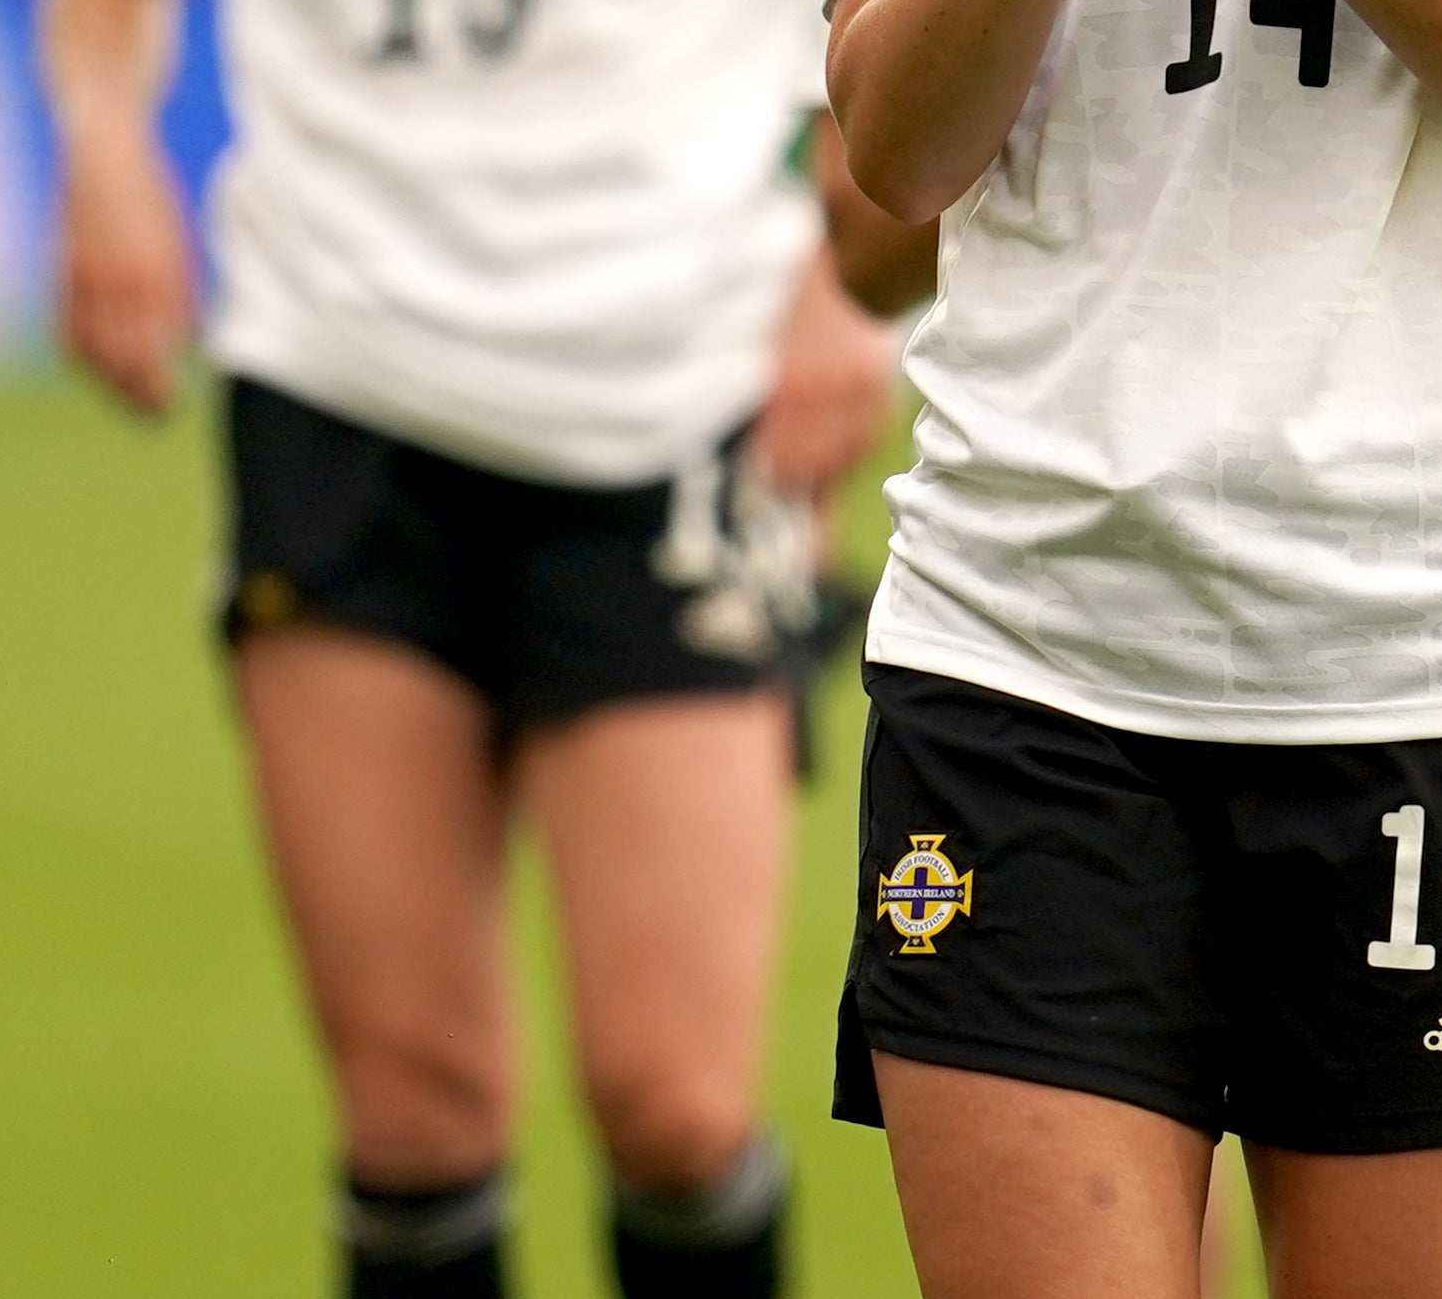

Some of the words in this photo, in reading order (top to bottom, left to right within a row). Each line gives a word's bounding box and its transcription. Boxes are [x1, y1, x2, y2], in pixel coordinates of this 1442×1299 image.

[894, 857, 913, 881] IRISH
[913, 855, 949, 881] FOOTBALL
[887, 889, 922, 898] NORTHERN
[924, 889, 956, 898] IRELAND
[893, 911, 946, 932] ASSOCIATION
